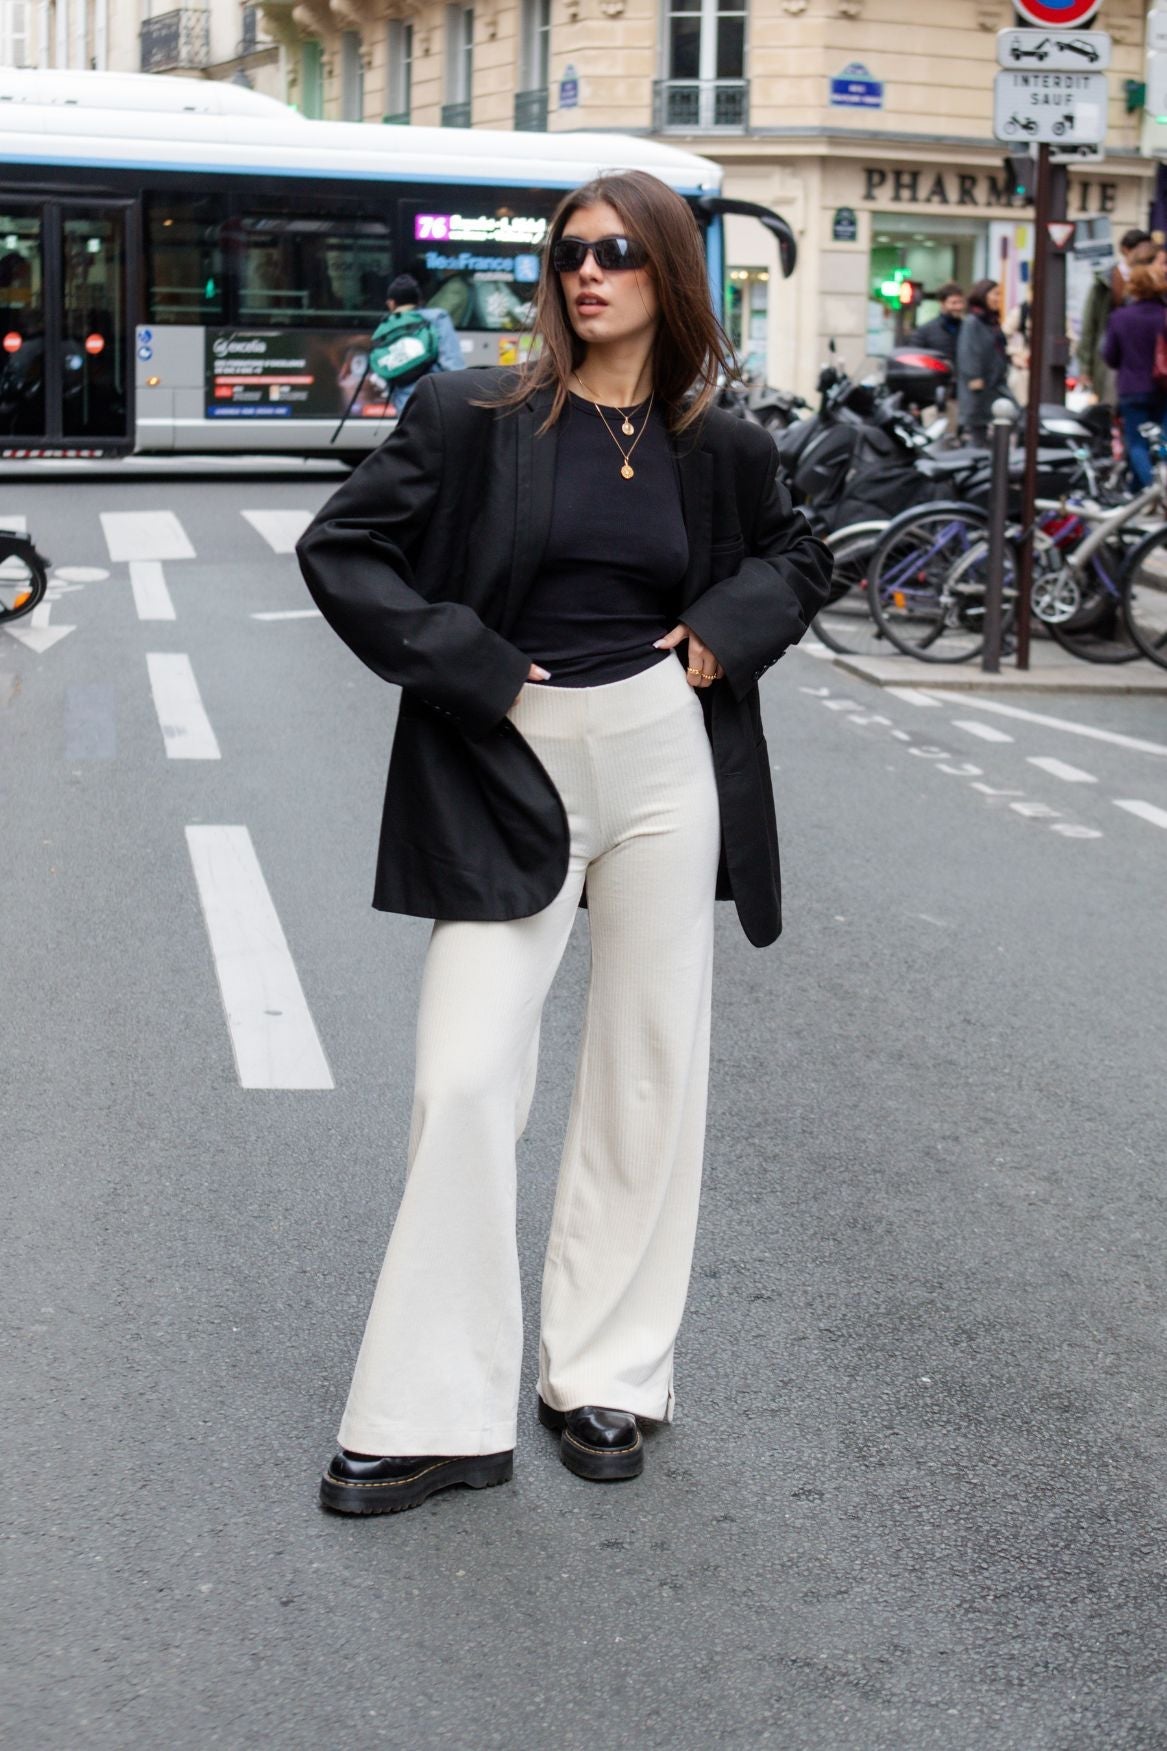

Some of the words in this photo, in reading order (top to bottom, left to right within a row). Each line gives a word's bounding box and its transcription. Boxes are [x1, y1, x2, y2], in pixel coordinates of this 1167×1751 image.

[1013, 74, 1091, 89] INTERDIT
[1030, 93, 1074, 106] SAUF
[863, 168, 1118, 213] PHARMIE
[418, 216, 448, 239] 76
